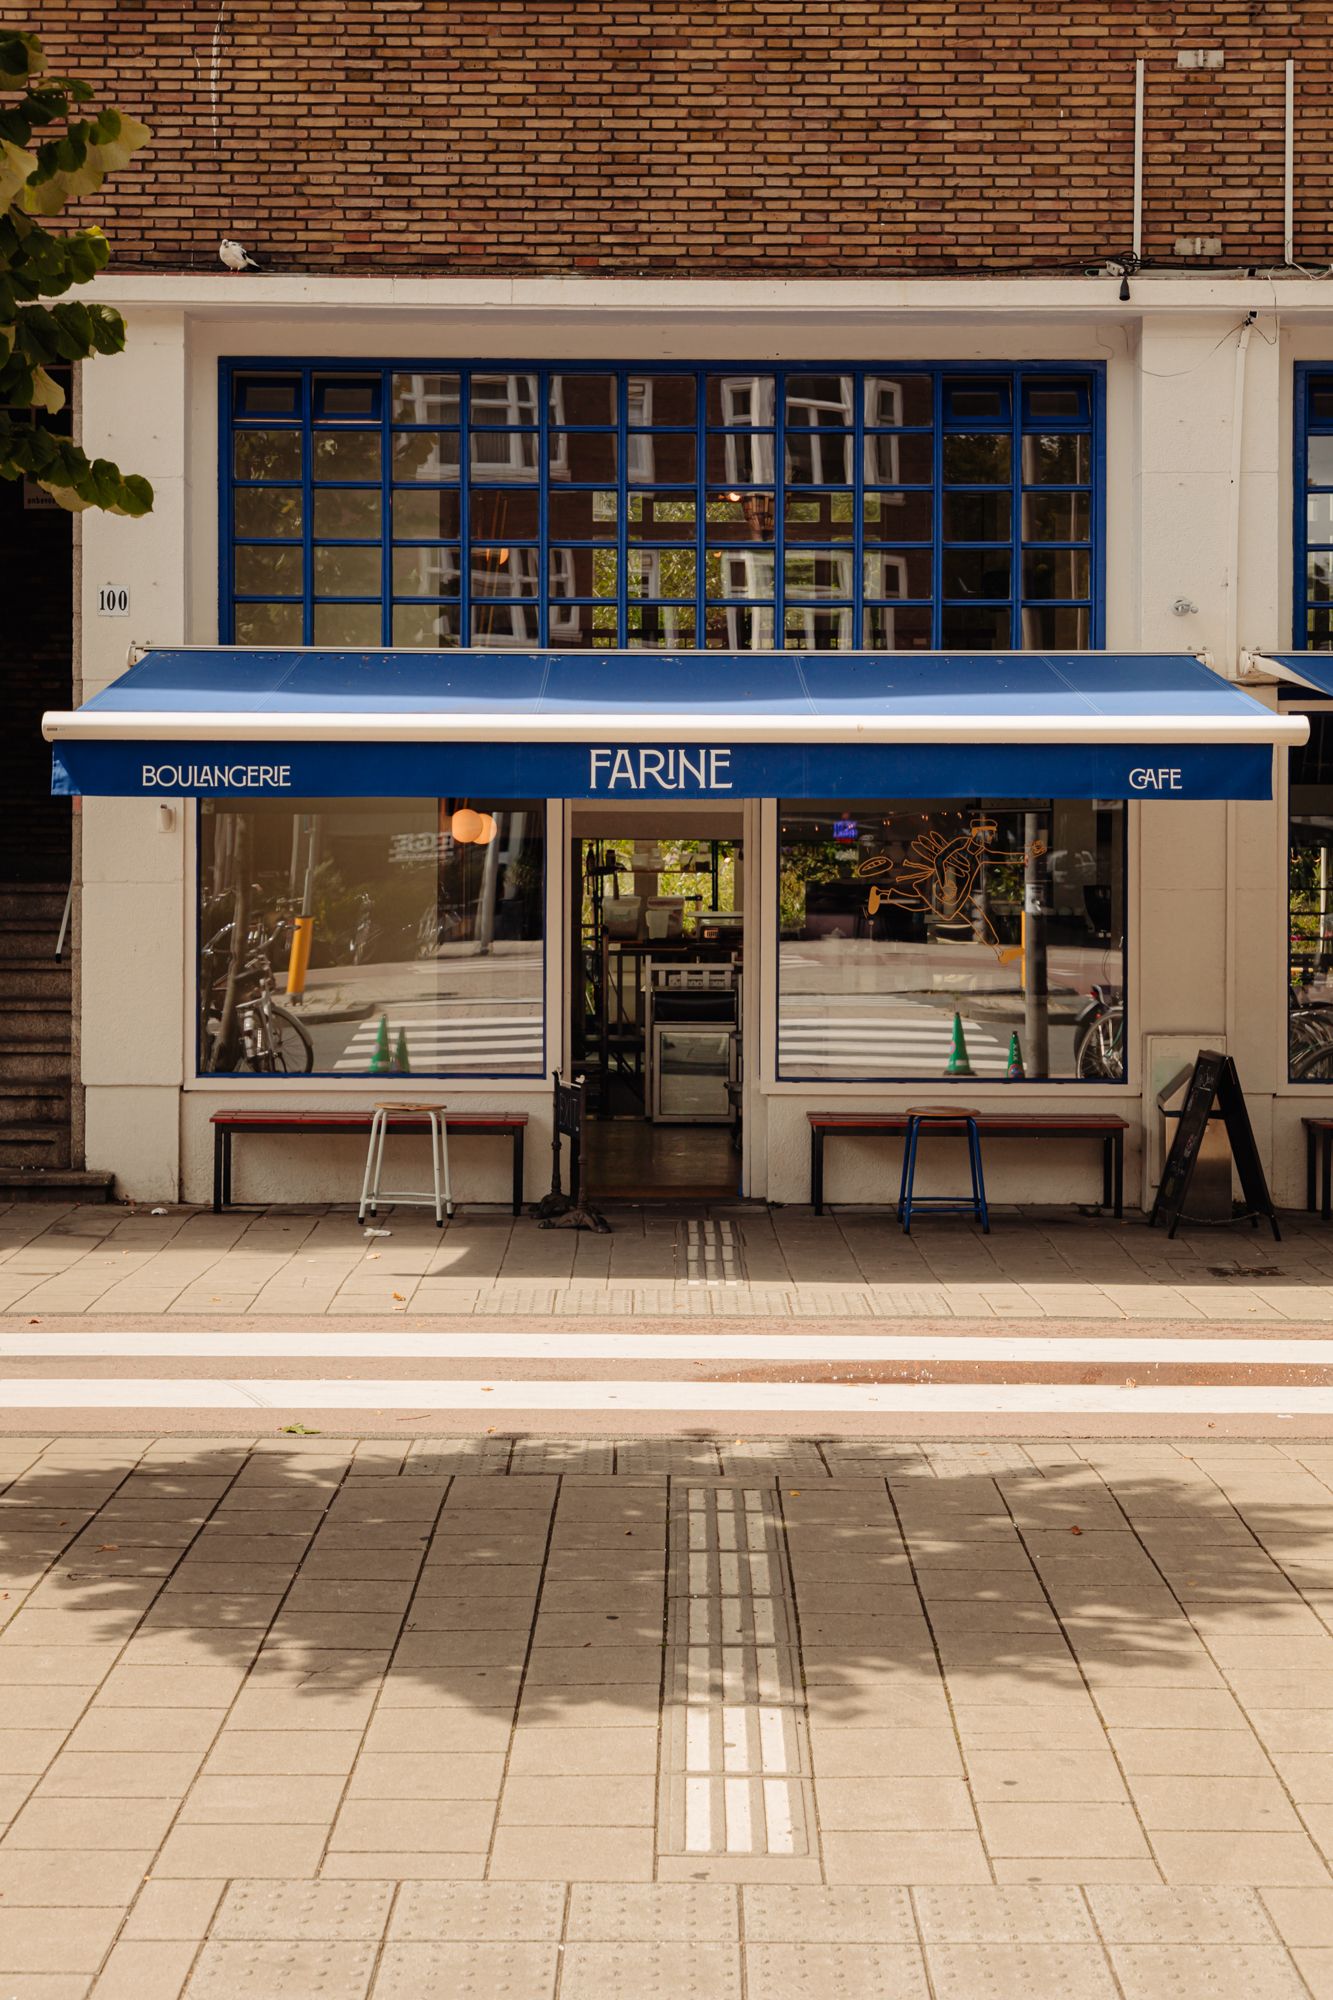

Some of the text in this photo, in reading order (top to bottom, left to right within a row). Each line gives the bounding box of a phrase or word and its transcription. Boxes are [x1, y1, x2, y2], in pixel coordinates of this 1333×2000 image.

[100, 590, 127, 611] 100
[142, 765, 291, 787] BOULANGERIE
[590, 749, 733, 789] FARINE
[1128, 768, 1183, 790] CAFE
